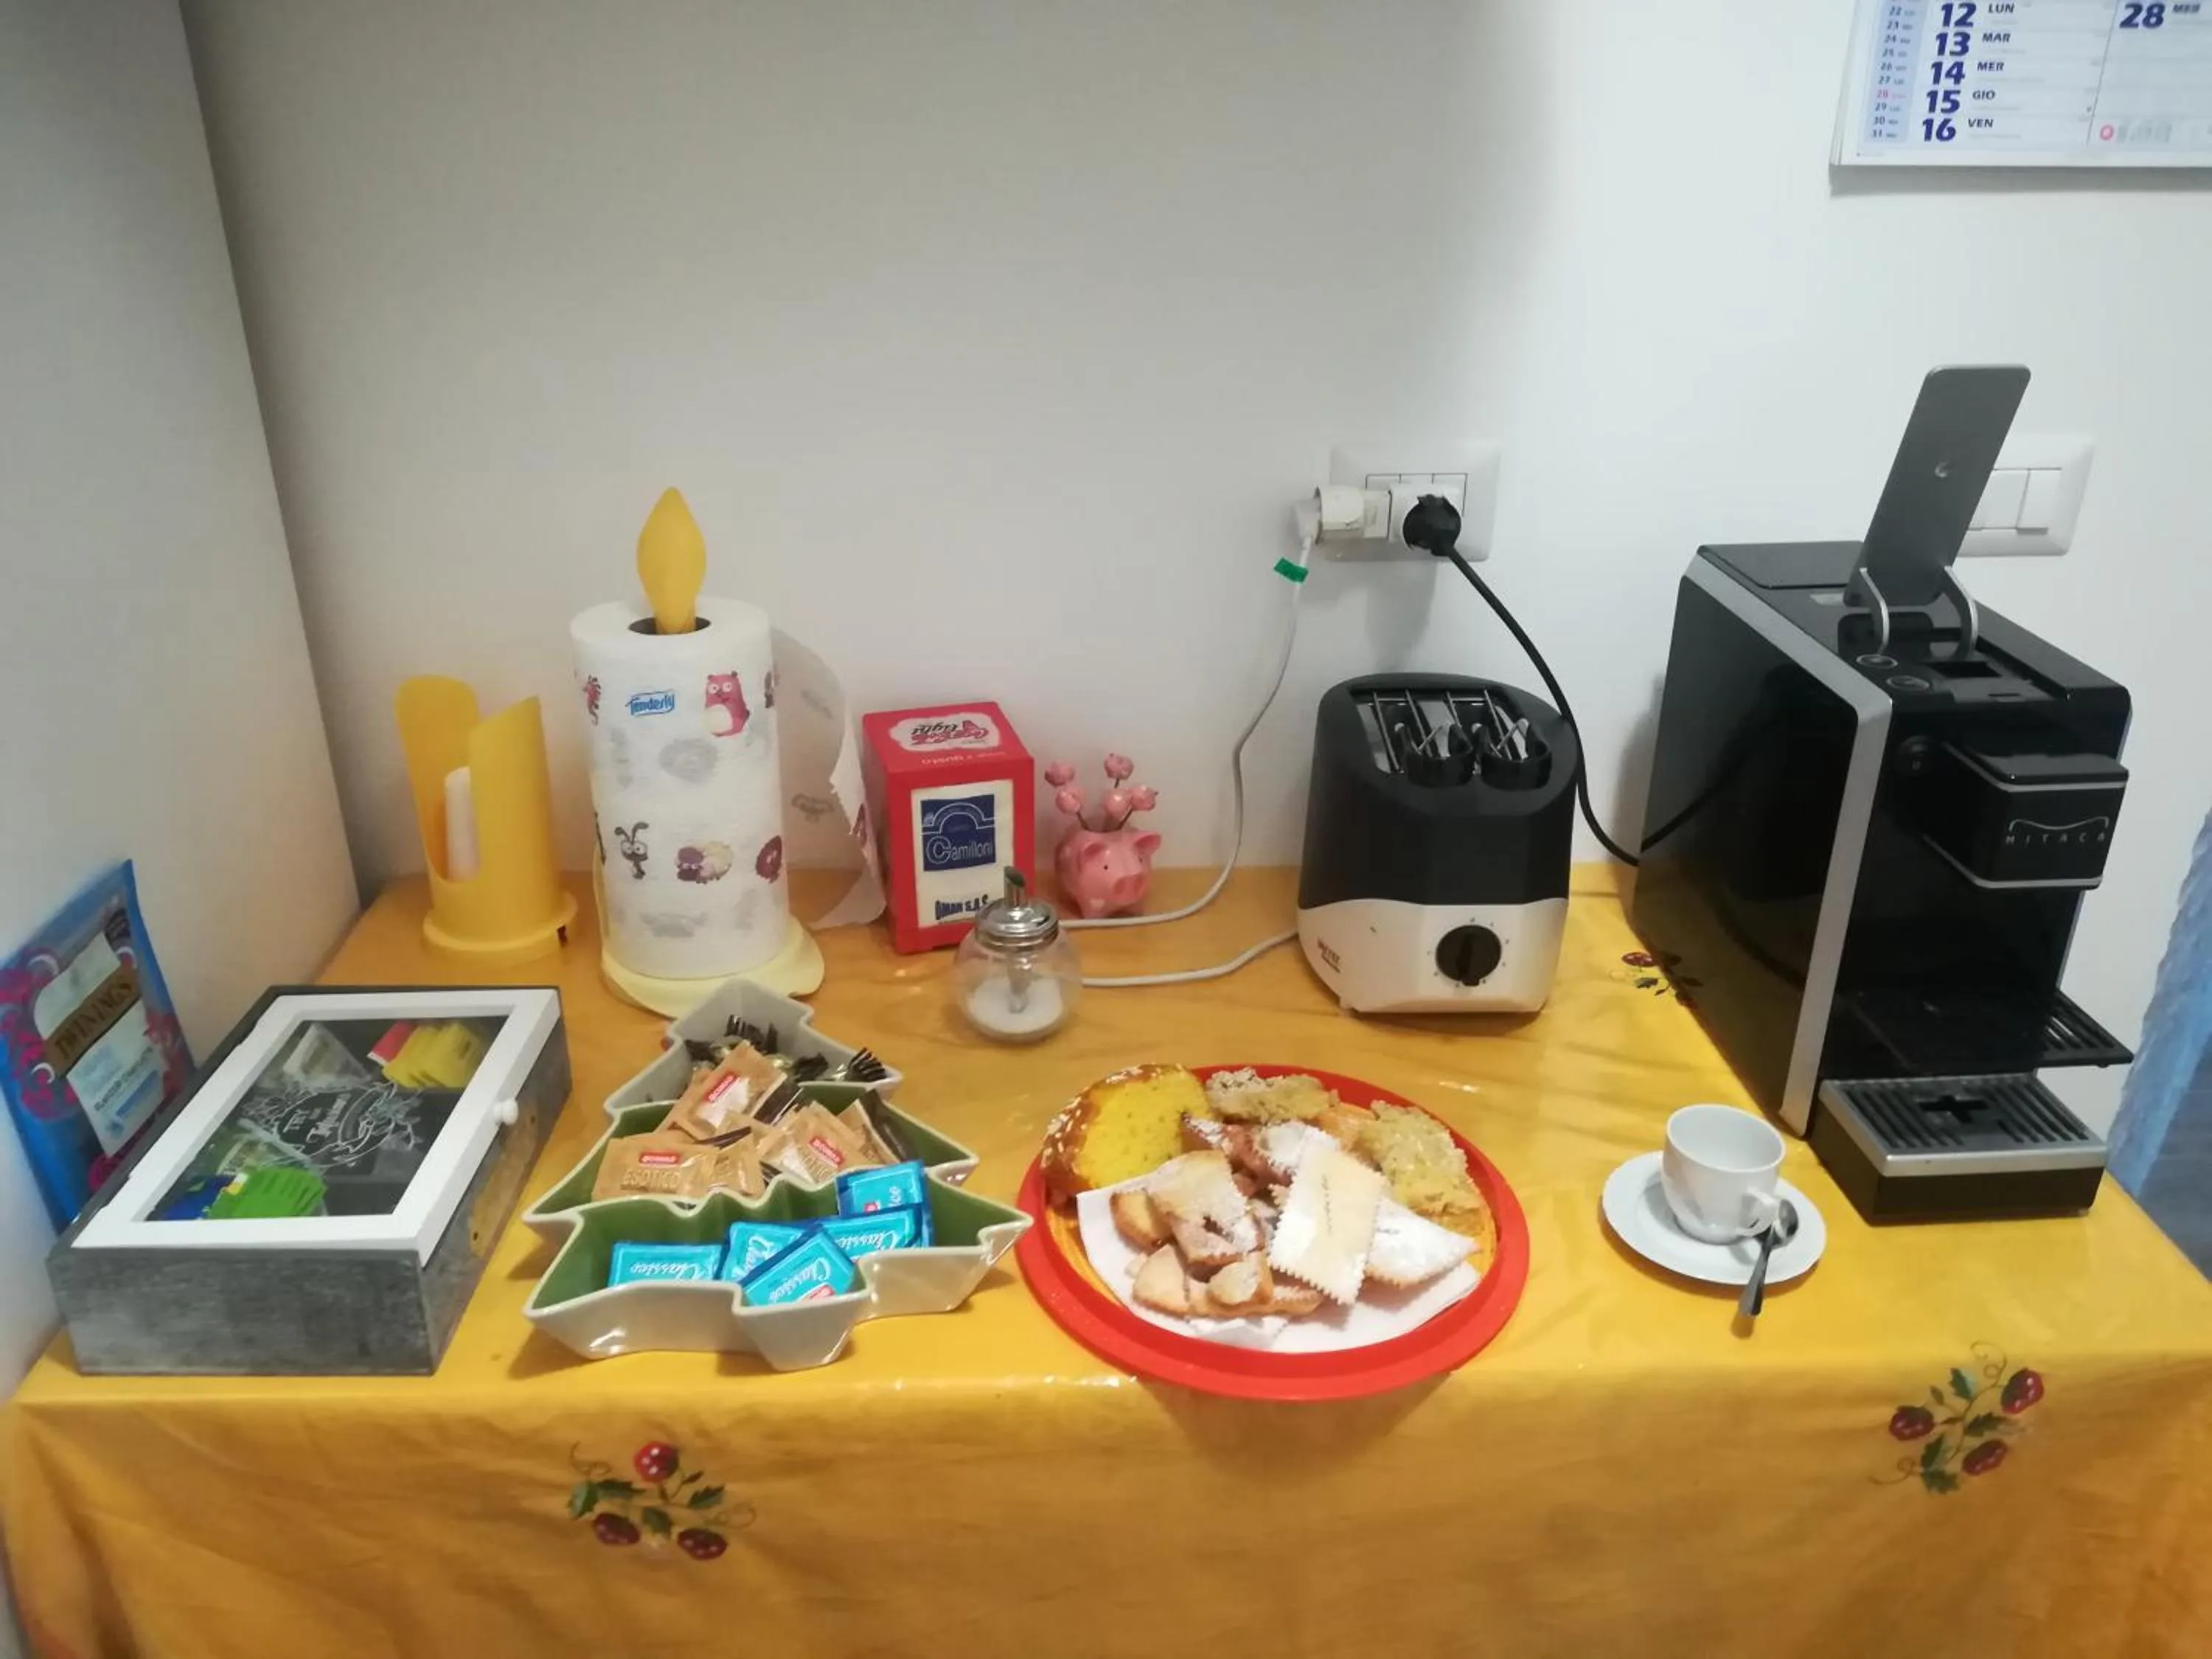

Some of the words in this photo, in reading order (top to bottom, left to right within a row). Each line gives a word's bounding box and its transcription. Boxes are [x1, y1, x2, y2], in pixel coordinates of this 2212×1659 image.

[1941, 2, 1977, 27] 12
[1988, 4, 2014, 13] LUN
[2119, 2, 2166, 28] 28
[1935, 32, 1971, 56] 13
[1982, 33, 2011, 43] MAR
[1931, 61, 1966, 85] 14
[1977, 61, 2004, 72] MER
[1926, 90, 1961, 114] 15
[1972, 90, 1996, 100] GIO
[1921, 118, 1957, 142] 16
[1968, 119, 1994, 128] VEN
[625, 693, 675, 716] Tenderly
[2005, 832, 2105, 844] MITACA
[54, 981, 132, 1060] TWININGS
